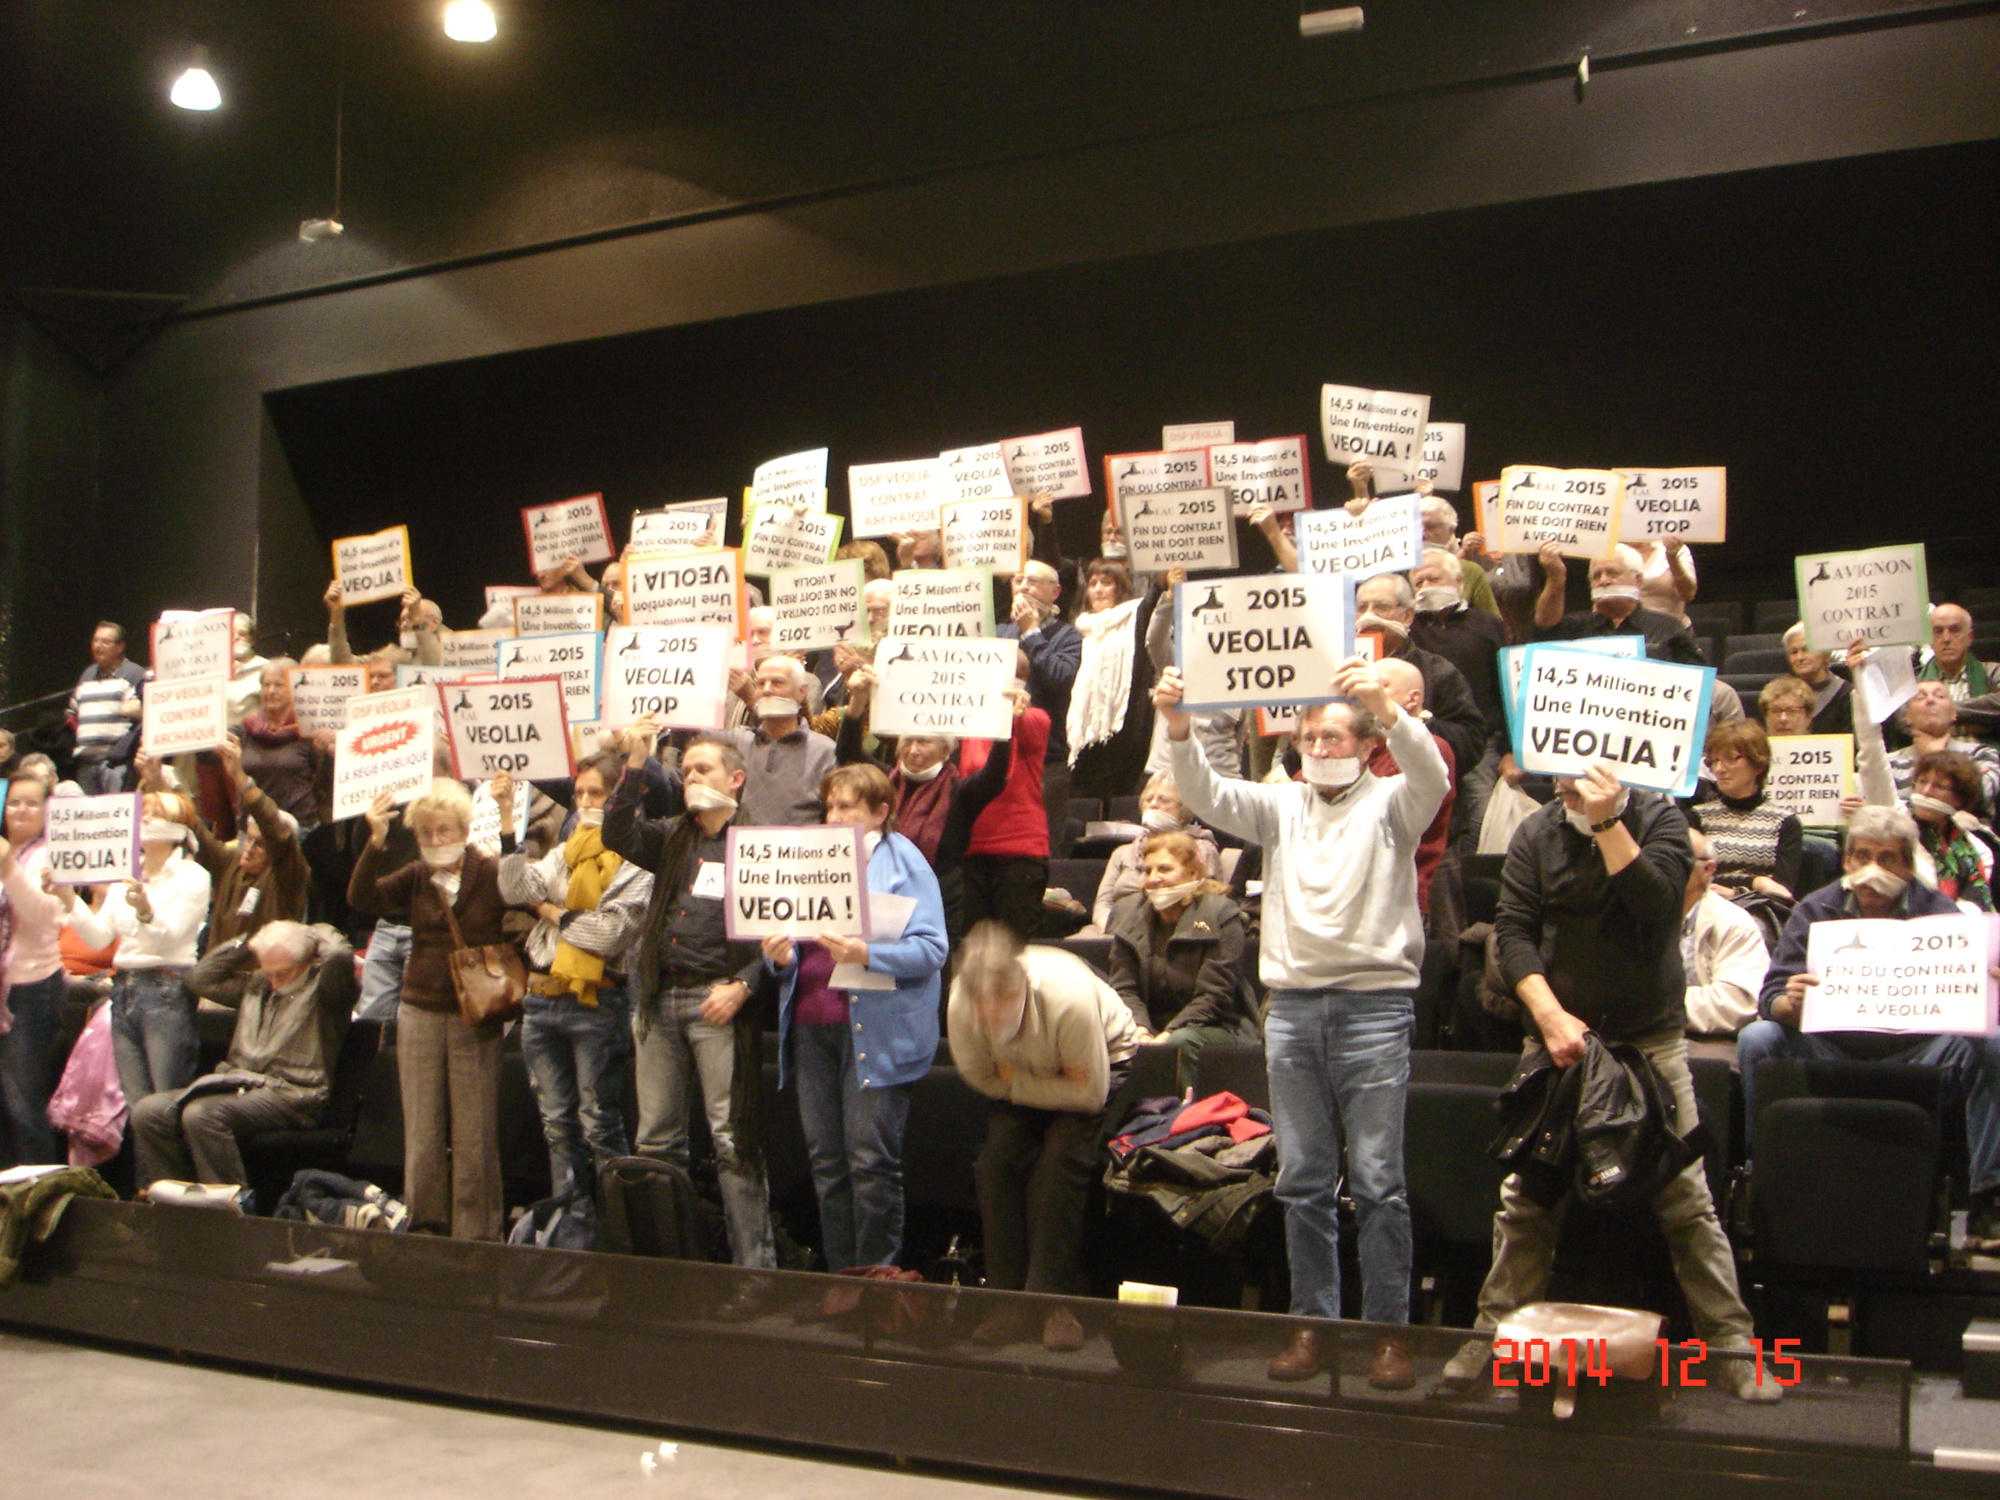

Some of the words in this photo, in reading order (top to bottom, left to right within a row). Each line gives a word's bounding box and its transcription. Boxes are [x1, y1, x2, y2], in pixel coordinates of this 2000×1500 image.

[1331, 398, 1354, 412] 14,5
[1357, 402, 1397, 415] Millions
[1330, 415, 1349, 426] Une
[1353, 418, 1414, 435] Invention
[1044, 442, 1070, 455] 2015
[1331, 434, 1397, 458] VEOLIA
[1405, 443, 1411, 459] !
[976, 451, 1001, 461] 2015
[1214, 454, 1238, 467] 14,5
[1242, 454, 1277, 464] Millions
[1038, 458, 1076, 470] CONTRAT
[1165, 461, 1198, 474] 2015
[860, 474, 882, 487] DSP
[955, 468, 1001, 482] VEOLIA
[1038, 473, 1057, 482] DOIT
[1059, 469, 1078, 479] RIEN
[1215, 471, 1238, 482] Une
[1241, 466, 1299, 480] Invention
[1119, 486, 1135, 494] FIN
[1139, 484, 1153, 492] DU
[1156, 479, 1203, 491] CONTRAT
[1564, 480, 1606, 495] 2015
[1661, 477, 1698, 489] 2015
[871, 491, 926, 505] CONTRAT
[961, 485, 992, 498] STOP
[1231, 485, 1288, 504] EOLIA
[1179, 500, 1216, 514] 2015
[1506, 499, 1524, 509] FIN
[1527, 500, 1544, 510] DU
[1548, 502, 1609, 516] CONTRAT
[1637, 499, 1701, 512] VEOLIA
[567, 506, 592, 520] 2015
[981, 509, 1013, 521] 2015
[669, 520, 698, 531] 2015
[798, 520, 826, 536] 2015
[1133, 527, 1149, 535] FIN
[1152, 525, 1167, 534] DU
[1170, 521, 1223, 533] CONTRAT
[1308, 521, 1337, 534] 14,5
[1505, 515, 1520, 525] ON
[1523, 515, 1539, 525] NE
[1542, 517, 1571, 528] DOIT
[1575, 519, 1607, 532] RIEN
[1647, 519, 1690, 533] STOP
[581, 532, 603, 544] RIEN
[970, 529, 1016, 539] CONTRAT
[1310, 540, 1338, 550] Une
[1344, 525, 1408, 547] Invention
[1523, 530, 1530, 540] A
[1533, 531, 1578, 544] VEOLIA
[754, 533, 768, 541] FIN
[771, 535, 785, 544] DU
[787, 537, 827, 553] CONTRAT
[993, 542, 1017, 550] RIEN
[1134, 540, 1149, 550] ON
[1152, 539, 1165, 548] NE
[1169, 538, 1194, 548] DOIT
[1198, 535, 1224, 545] RIEN
[752, 545, 765, 553] ON
[768, 547, 780, 556] NE
[1154, 553, 1160, 562] A
[1164, 551, 1204, 561] VEOLIA
[1312, 544, 1395, 573] VEOLIA
[1833, 558, 1911, 580] AVIGNON
[343, 570, 394, 592] VEOLIA
[644, 565, 729, 591] VEOLIA
[794, 575, 826, 588] VEOLIA
[825, 589, 837, 599] NE
[841, 586, 857, 597] ON
[899, 584, 921, 597] 14,5
[1846, 584, 1877, 600] 2015
[633, 596, 696, 613] Invention
[701, 594, 731, 606] Une
[776, 594, 797, 605] RIEN
[840, 601, 857, 612] FIN
[1203, 612, 1232, 625] EAU
[1247, 587, 1307, 610] 2015
[521, 605, 541, 617] 14,5
[776, 606, 820, 620] CONTRAT
[823, 604, 836, 614] DU
[896, 603, 918, 615] Une
[923, 602, 981, 615] Invention
[1823, 603, 1903, 623] CONTRAT
[521, 621, 540, 631] Une
[543, 617, 591, 631] Invention
[780, 626, 811, 641] 2015
[1208, 626, 1313, 654] VEOLIA
[1837, 625, 1890, 642] CADUC
[658, 637, 698, 653] 2015
[549, 646, 584, 662] 2015
[917, 650, 1003, 664] AVIGNON
[332, 675, 359, 687] 2015
[625, 667, 695, 685] VEOLIA
[932, 671, 966, 685] 2015
[1226, 664, 1296, 691] STOP
[565, 686, 590, 696] RIEN
[1536, 666, 1578, 687] 14,5
[1586, 673, 1657, 696] Millions
[1663, 684, 1693, 702] d'€
[151, 690, 172, 705] DSP
[308, 695, 321, 704] DU
[489, 693, 533, 711] 2015
[899, 691, 987, 706] CONTRAT
[321, 707, 342, 716] DOIT
[353, 705, 372, 719] DSP
[632, 696, 678, 714] STOP
[160, 704, 210, 723] CONTRAT
[913, 713, 971, 726] CADUC
[1533, 694, 1573, 714] Une
[1579, 698, 1687, 731] Invention
[361, 726, 407, 750] URGENT
[466, 723, 542, 744] VEOLIA
[1531, 726, 1657, 769] VEOLIA
[1670, 745, 1681, 772] !
[381, 750, 428, 772] PUBLIQUE
[482, 753, 529, 772] STOP
[1790, 751, 1832, 764] 2015
[1778, 774, 1839, 785] CONTRAT
[341, 790, 366, 806] C'EST
[368, 785, 379, 798] LE
[382, 774, 425, 796] MOMENT
[1776, 790, 1805, 800] DOIT
[1809, 789, 1839, 799] RIEN
[51, 809, 71, 823] 14,5
[50, 828, 69, 841] Une
[73, 826, 128, 840] Invention
[50, 848, 116, 869] VEOLIA
[122, 847, 127, 866] !
[739, 843, 772, 862] 14,5
[777, 846, 823, 859] Millions
[827, 844, 851, 858] d'€
[738, 868, 770, 885] Une
[775, 868, 852, 885] Invention
[739, 895, 836, 921] VEOLIA
[846, 894, 853, 919] !
[1911, 934, 1969, 951] 2015
[1826, 966, 1853, 977] FIN
[1862, 966, 1886, 977] DU
[1893, 964, 1976, 978] CONTRAT
[1825, 984, 1849, 995] ON
[1857, 984, 1879, 996] NE
[1888, 984, 1927, 996] DOIT
[1936, 983, 1978, 995] RIEN
[1857, 1004, 1867, 1014] A
[1876, 1003, 1941, 1016] VEOLIA
